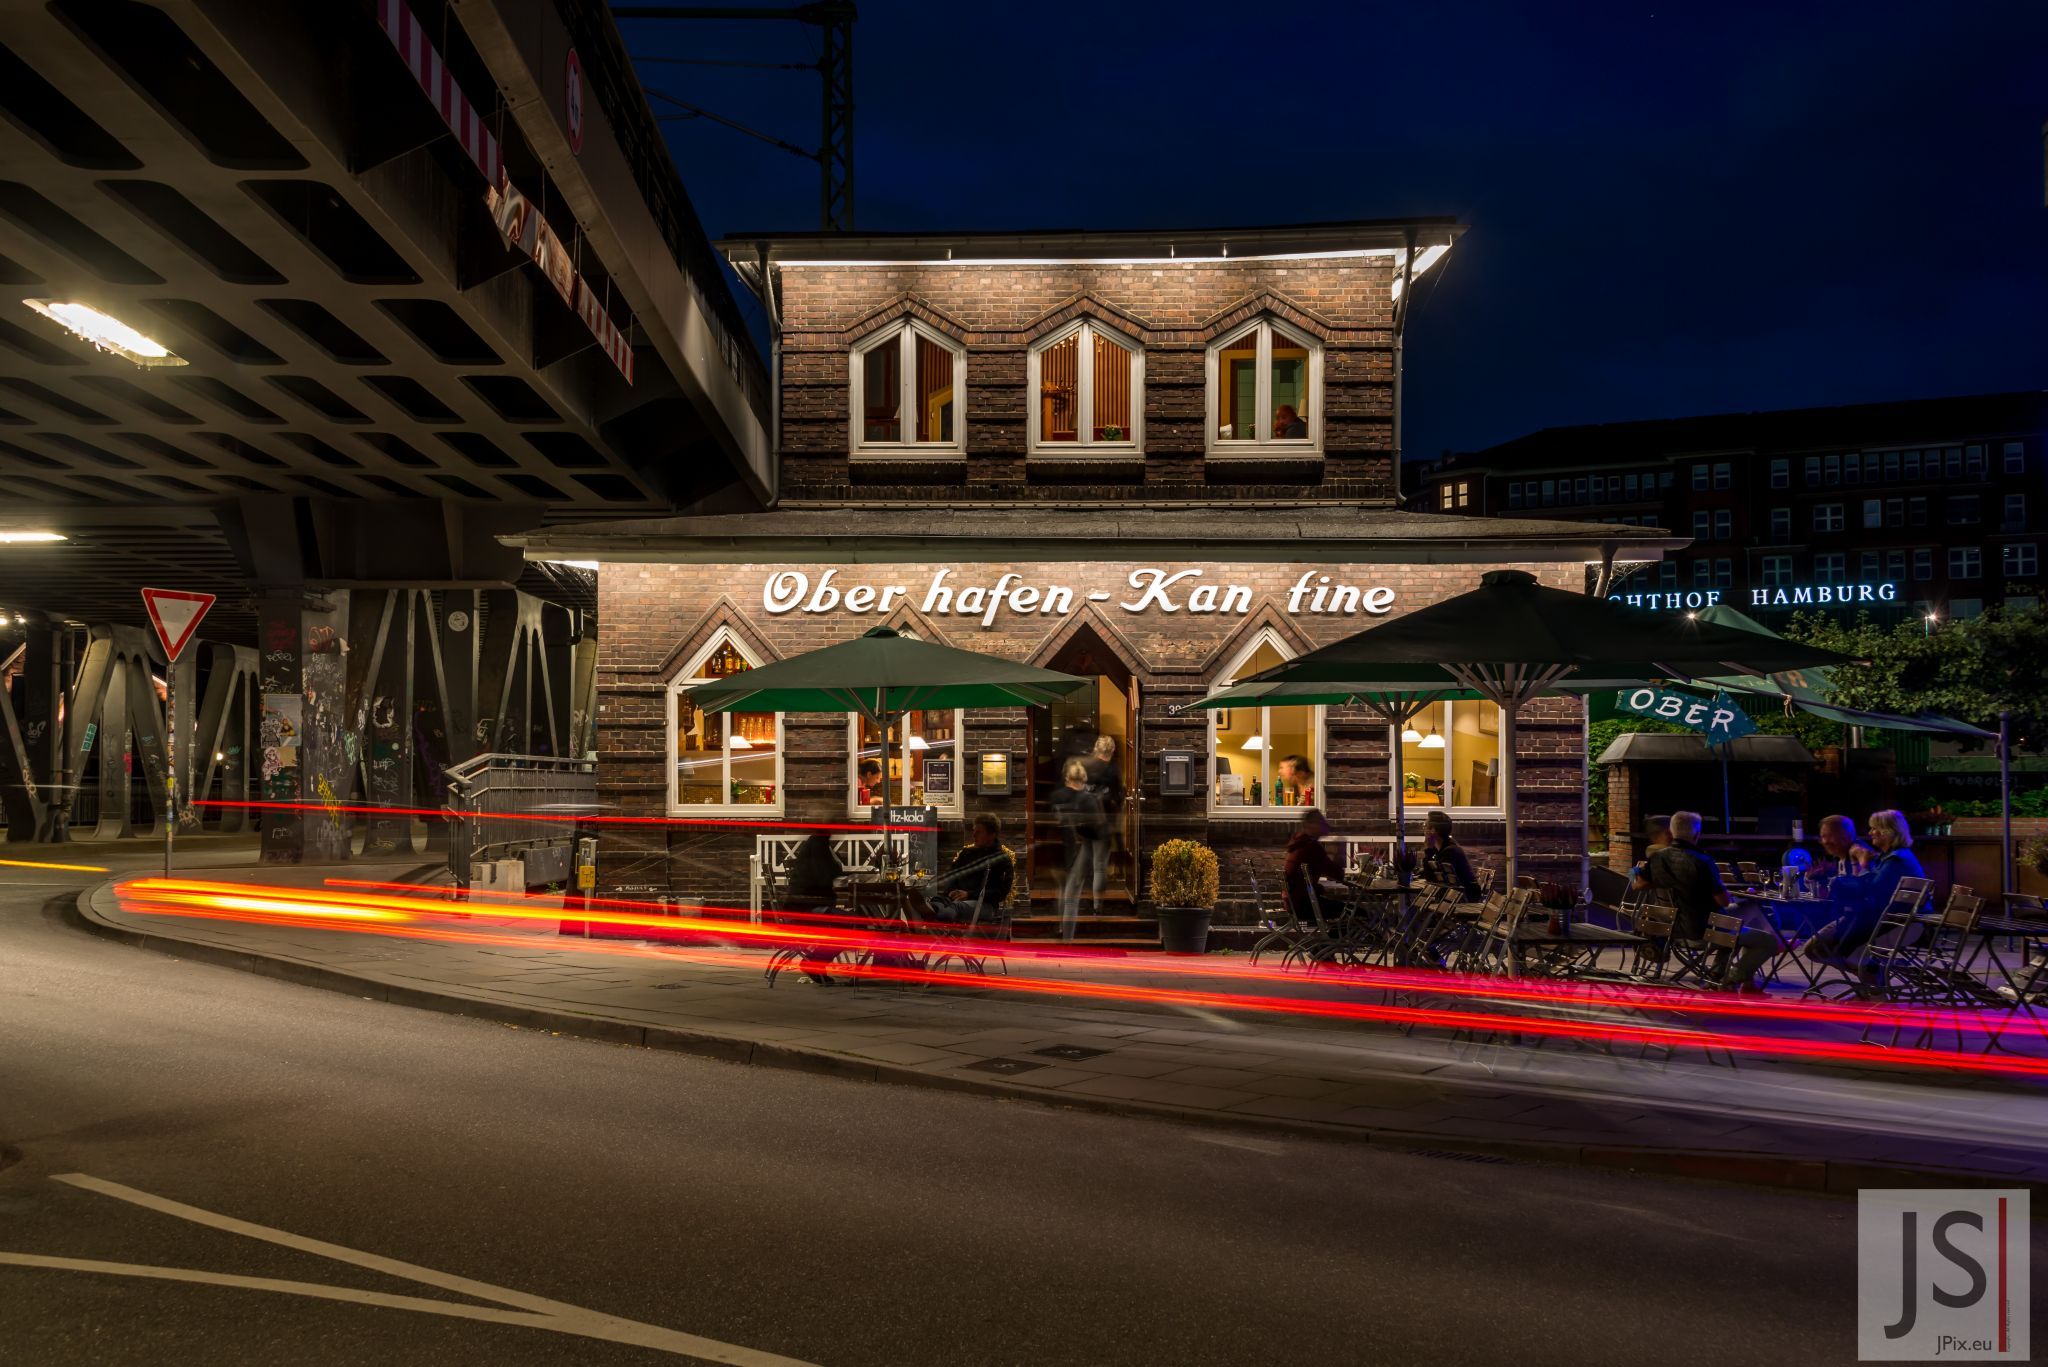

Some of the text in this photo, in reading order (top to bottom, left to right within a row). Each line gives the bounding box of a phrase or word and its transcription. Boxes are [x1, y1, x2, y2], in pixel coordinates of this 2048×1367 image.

[764, 570, 907, 613] Ober
[917, 566, 1074, 626] hafen
[1121, 568, 1253, 613] Kan
[1752, 583, 1895, 606] HAMBURG
[1629, 688, 1736, 733] OBER
